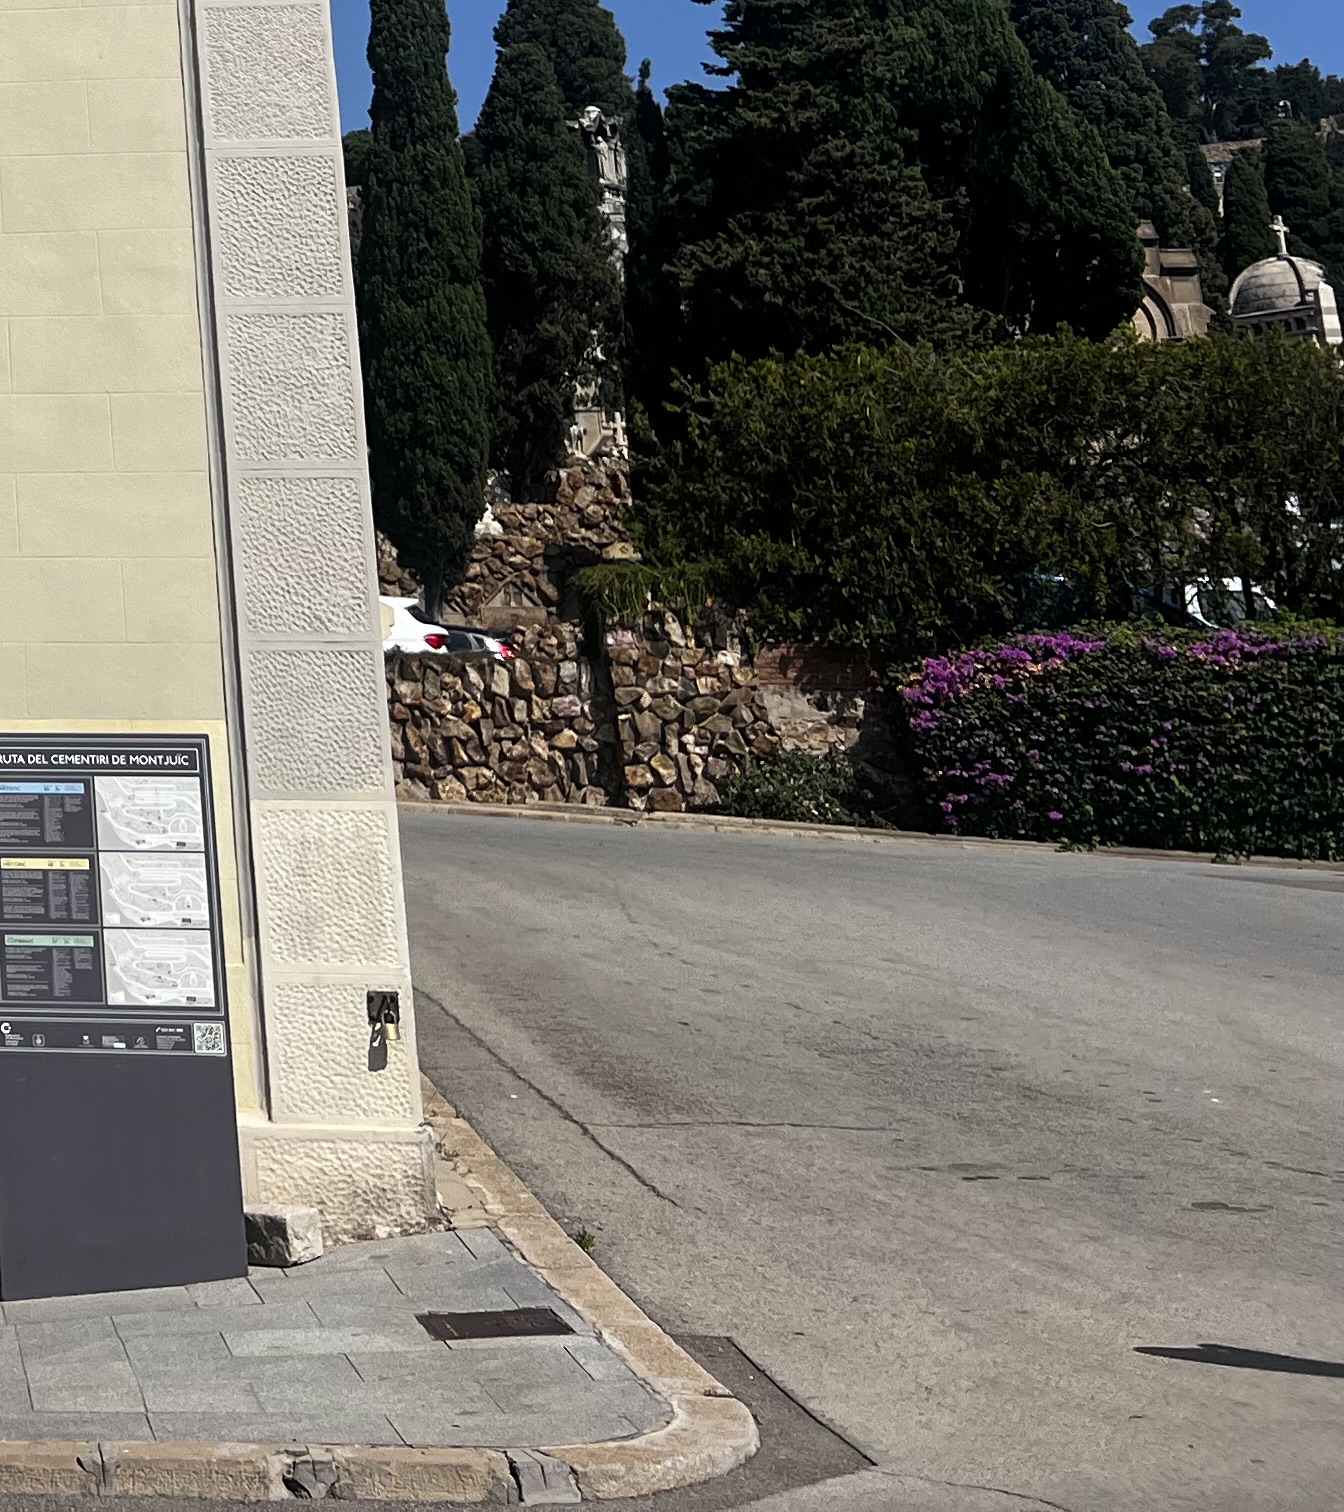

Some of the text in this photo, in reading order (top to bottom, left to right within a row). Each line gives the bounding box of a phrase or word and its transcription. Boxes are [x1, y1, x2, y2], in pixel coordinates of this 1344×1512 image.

[27, 753, 49, 765] DEL
[50, 753, 109, 766] CEMENTIRI
[111, 754, 127, 766] DE
[129, 752, 189, 767] MONTJUÏC
